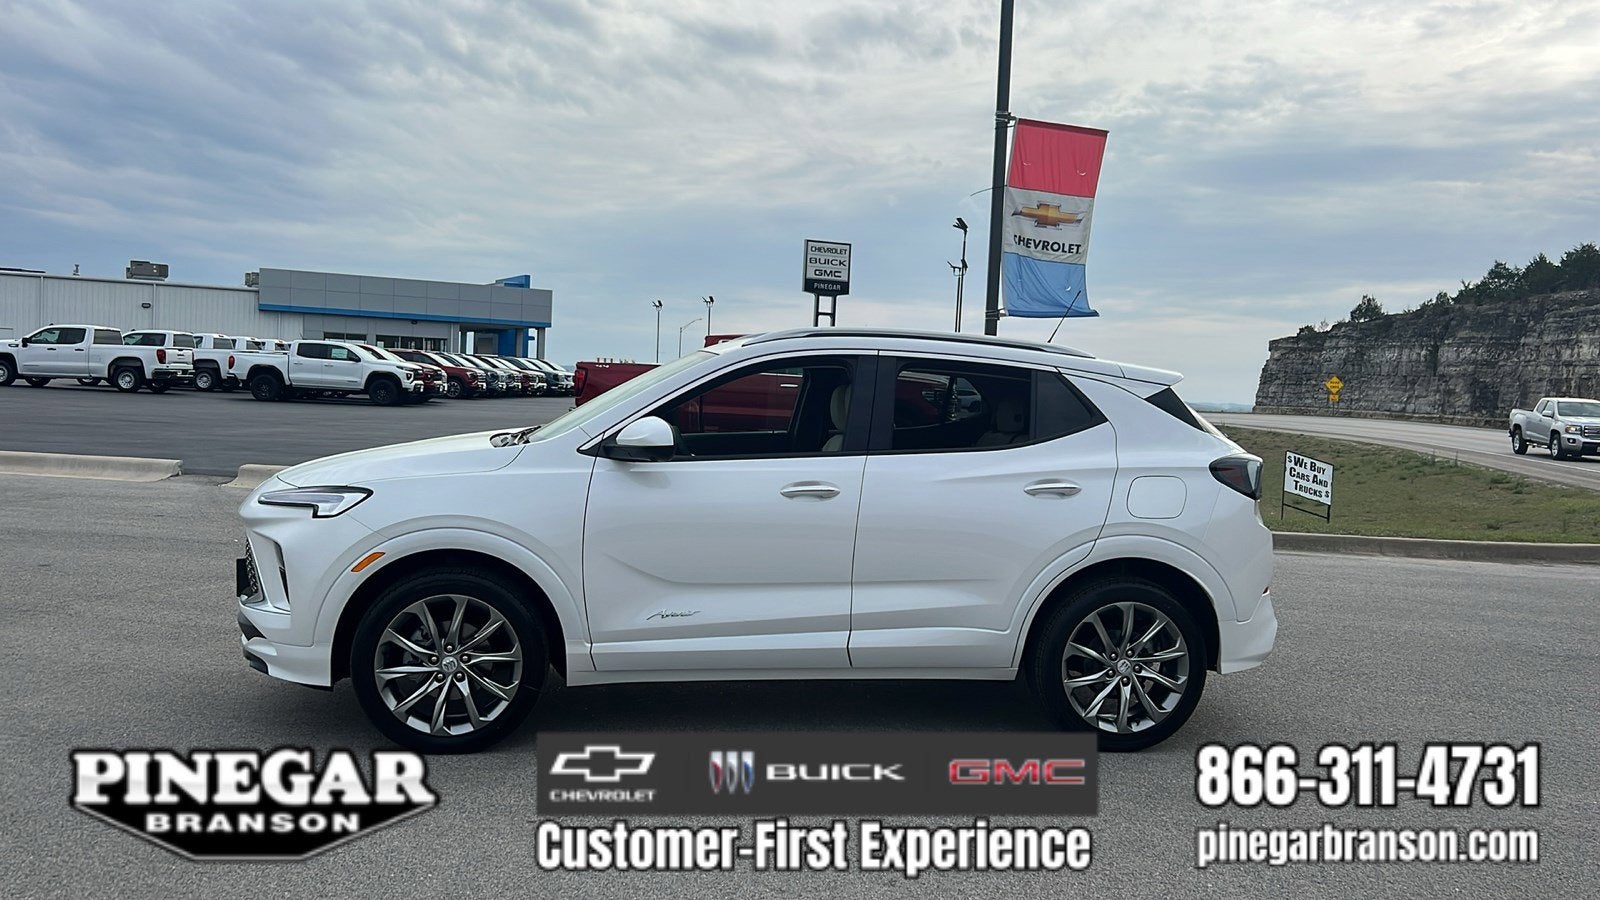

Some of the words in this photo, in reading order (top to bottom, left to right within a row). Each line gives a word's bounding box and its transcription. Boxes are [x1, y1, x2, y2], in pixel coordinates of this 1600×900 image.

[810, 245, 848, 255] CHEVROLET
[809, 257, 848, 267] BUICK
[813, 268, 842, 278] GMC
[813, 282, 841, 291] PINEGAR
